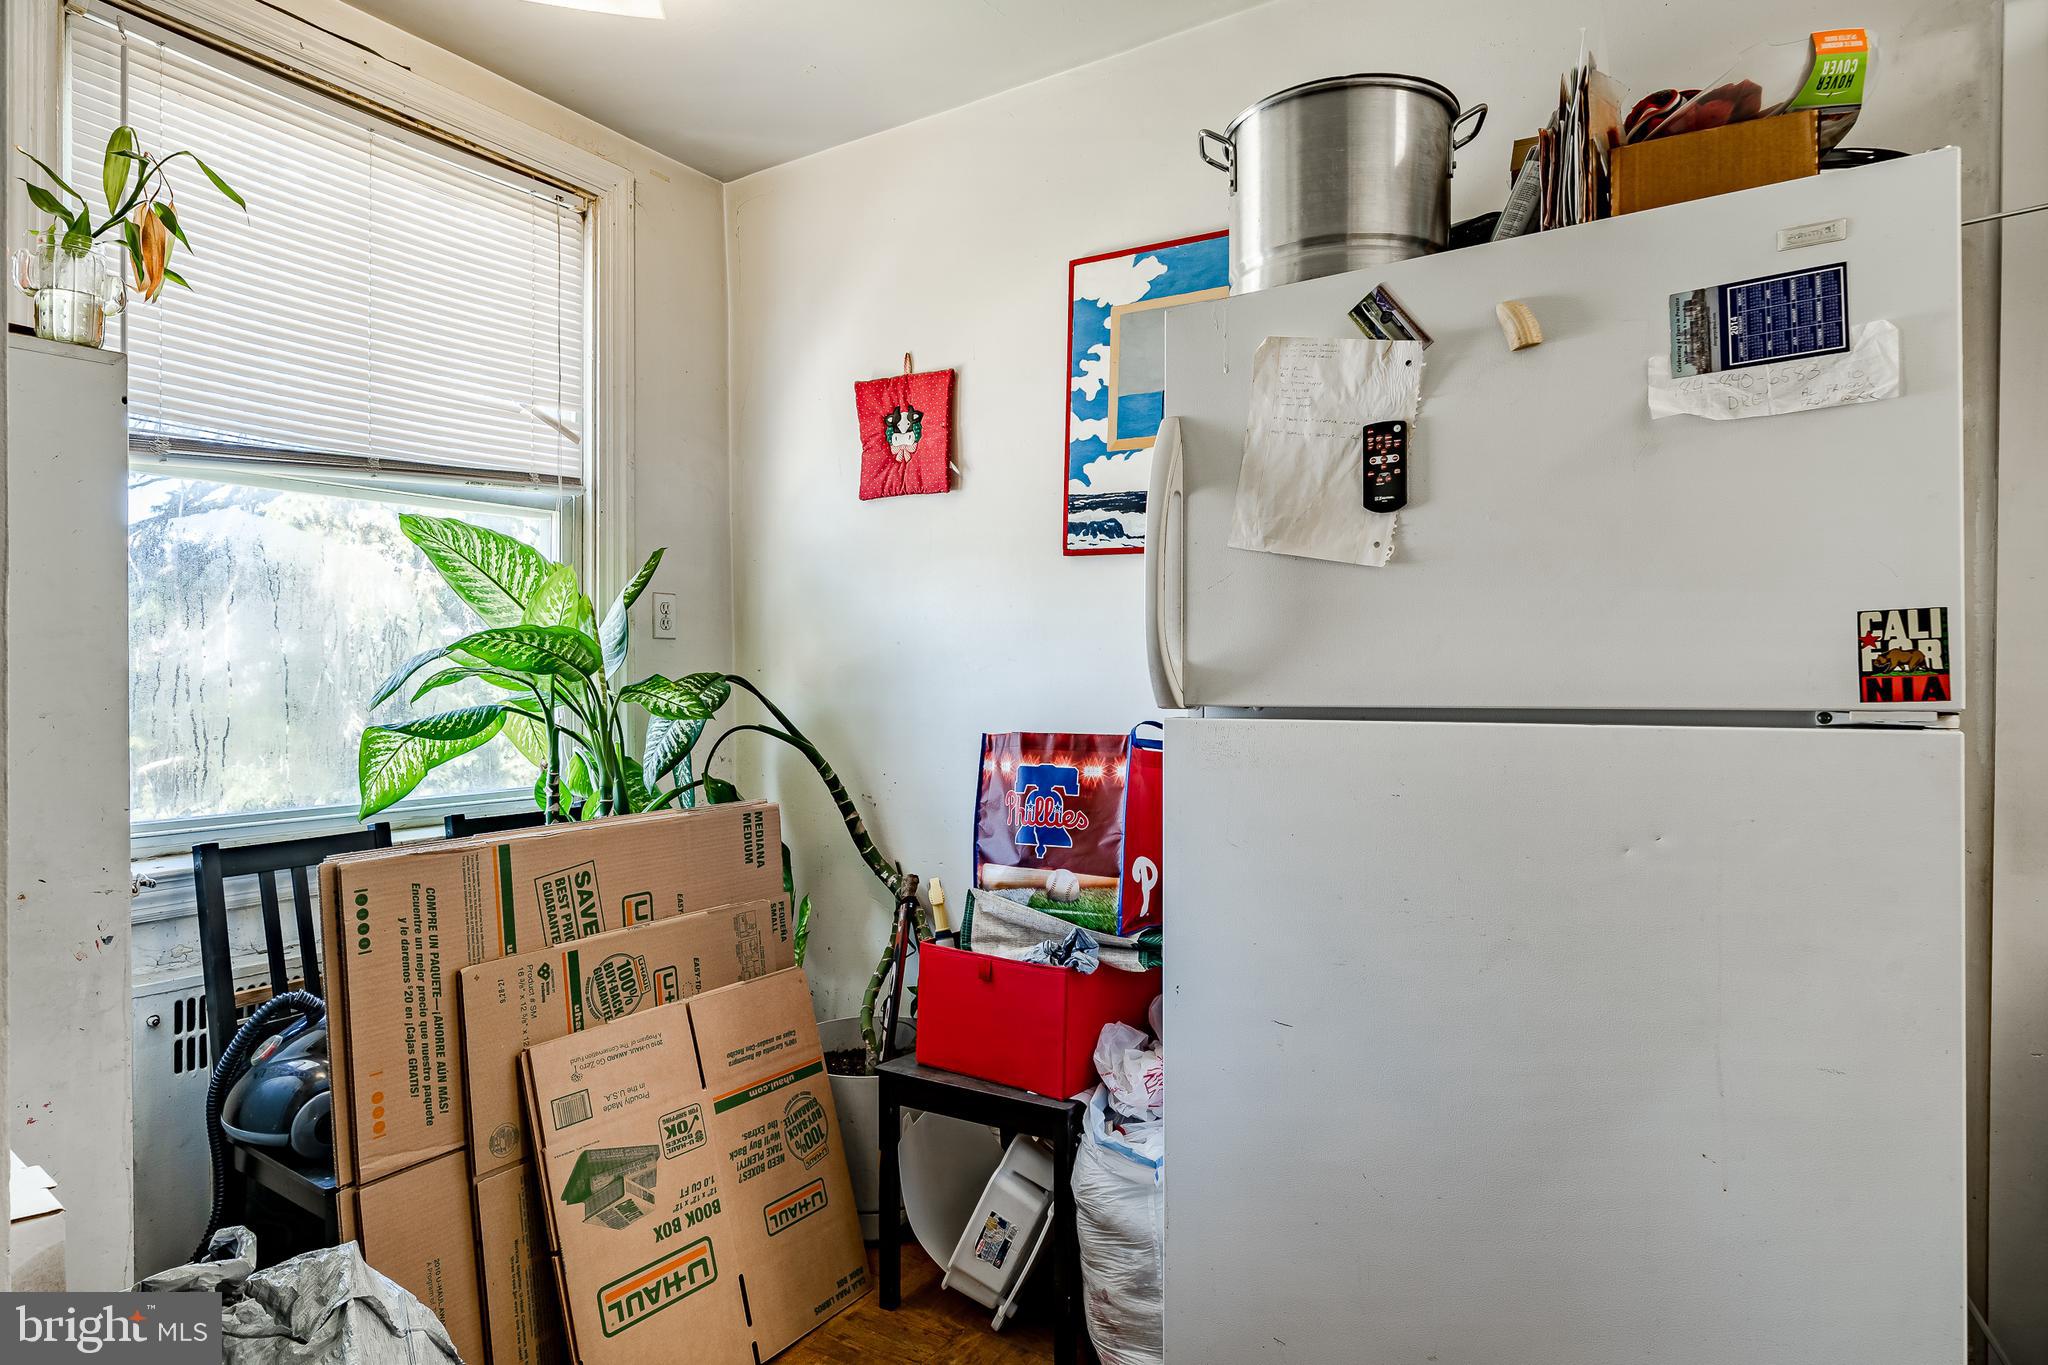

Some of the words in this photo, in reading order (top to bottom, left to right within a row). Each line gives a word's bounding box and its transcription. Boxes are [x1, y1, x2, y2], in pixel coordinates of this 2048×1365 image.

[1822, 59, 1858, 75] COVER
[1816, 74, 1854, 90] HOVER
[1730, 316, 1738, 336] 2014
[1860, 608, 1942, 640] CALI
[1866, 676, 1948, 702] NIA
[1005, 790, 1089, 830] Phillies
[743, 813, 753, 865] MEDIUM
[755, 811, 765, 868] MEDIANA
[555, 877, 569, 909] BEST
[1132, 856, 1158, 917] P
[412, 883, 422, 934] Encuentre
[426, 887, 438, 931] COMPRE
[574, 870, 600, 938] SAVE
[770, 903, 778, 933] SMALL
[778, 901, 787, 943] PEQUEÑA
[400, 926, 409, 936] le
[415, 937, 423, 949] un
[429, 934, 439, 949] UN
[401, 939, 411, 983] daremos
[415, 953, 425, 982] mejor
[603, 962, 624, 1017] BUY-BACK
[616, 959, 639, 1006] 100%
[416, 985, 428, 1017] precio
[593, 966, 613, 1024] GUARANTEE
[405, 1007, 413, 1019] en
[521, 1003, 527, 1012] 12
[530, 1005, 537, 1019] SM
[404, 1023, 416, 1055] ¡Cajas
[418, 1021, 428, 1039] que
[636, 1034, 657, 1043] Program
[585, 1046, 619, 1060] Conservation
[651, 1039, 663, 1048] 2010
[422, 1042, 432, 1081] nuestro
[570, 1057, 584, 1065] Fund
[580, 1061, 595, 1070] Zero
[596, 1058, 606, 1066] Go
[607, 1051, 628, 1061] AWARD
[408, 1058, 419, 1098] GRATIS!
[437, 1061, 449, 1083] AÚN
[627, 1084, 637, 1092] the
[749, 1074, 795, 1097] uhaul.com
[422, 1085, 435, 1126] paquete
[438, 1086, 450, 1114] MÁS!
[603, 1101, 623, 1112] Made
[624, 1092, 650, 1105] Proudly
[662, 1110, 687, 1125] SHIPPING
[688, 1107, 699, 1117] FOR
[782, 1097, 818, 1128] GUARANTEE
[664, 1119, 689, 1139] OK
[742, 1124, 765, 1140] Extras.
[768, 1120, 778, 1130] the
[665, 1133, 693, 1148] BOXES
[750, 1139, 763, 1151] Buy
[764, 1131, 780, 1145] We'll
[795, 1125, 825, 1156] 100%
[729, 1148, 747, 1161] Back
[767, 1142, 783, 1157] TAKE
[737, 1152, 765, 1171] PLENTY!
[768, 1153, 785, 1168] NEED
[704, 1175, 715, 1187] 1.0
[739, 1162, 765, 1183] BOXES?
[679, 1185, 690, 1199] FT
[691, 1181, 701, 1193] CU
[685, 1198, 721, 1228] BOOK
[653, 1217, 682, 1243] BOX
